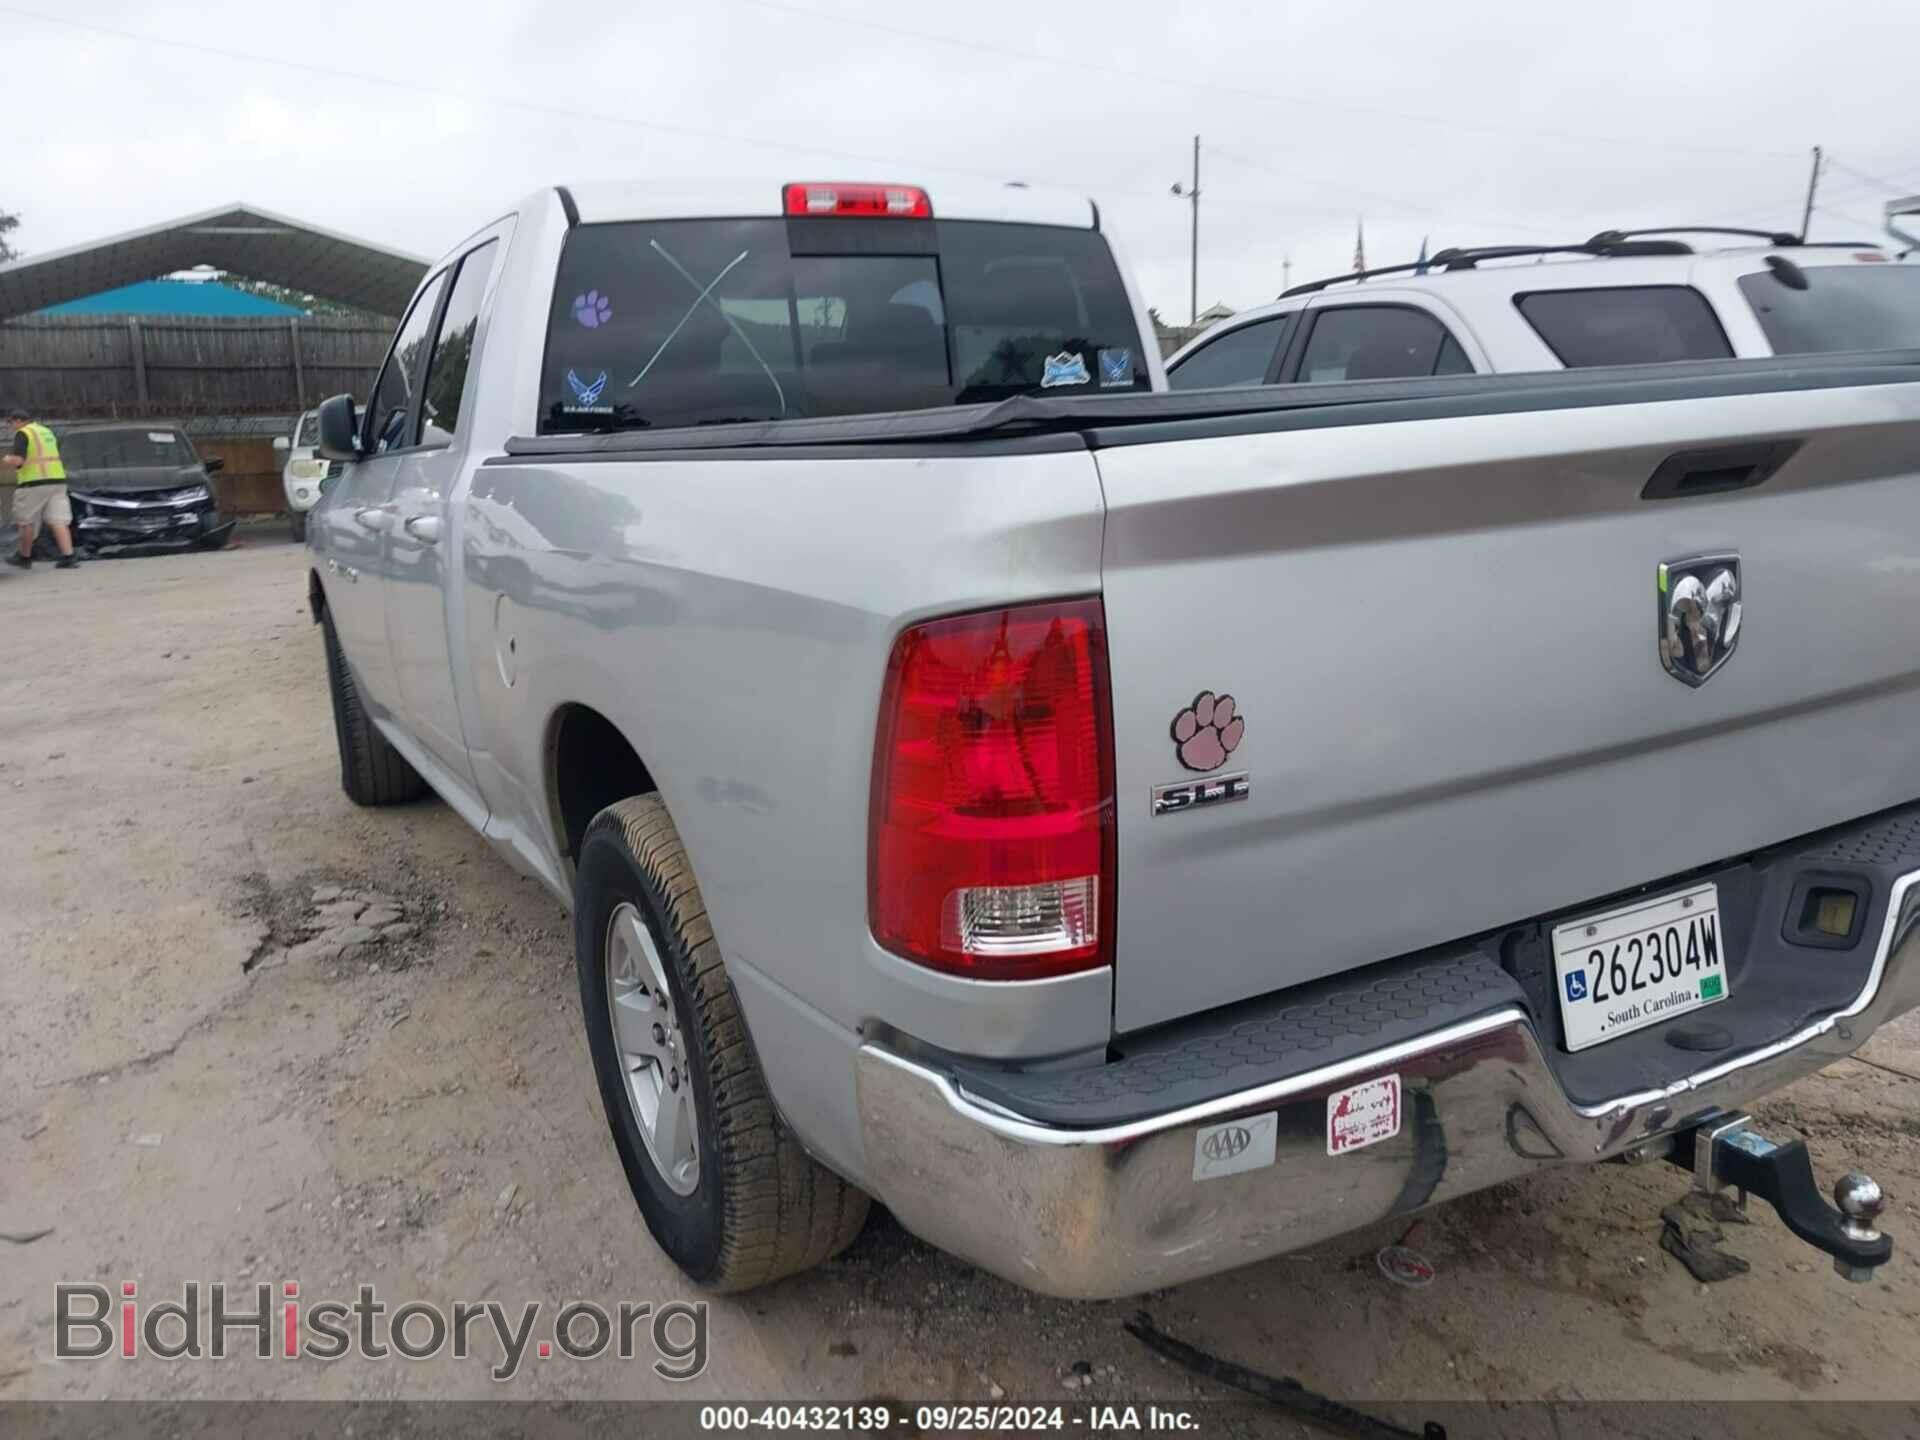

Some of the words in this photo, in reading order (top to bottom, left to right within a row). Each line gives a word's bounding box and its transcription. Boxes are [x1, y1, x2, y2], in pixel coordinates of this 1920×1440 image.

[1162, 777, 1243, 809] SLT
[1588, 914, 1718, 1004] 262304W
[1607, 1004, 1641, 1028] South
[1643, 990, 1692, 1015] Carolina
[1205, 1127, 1247, 1159] AAA
